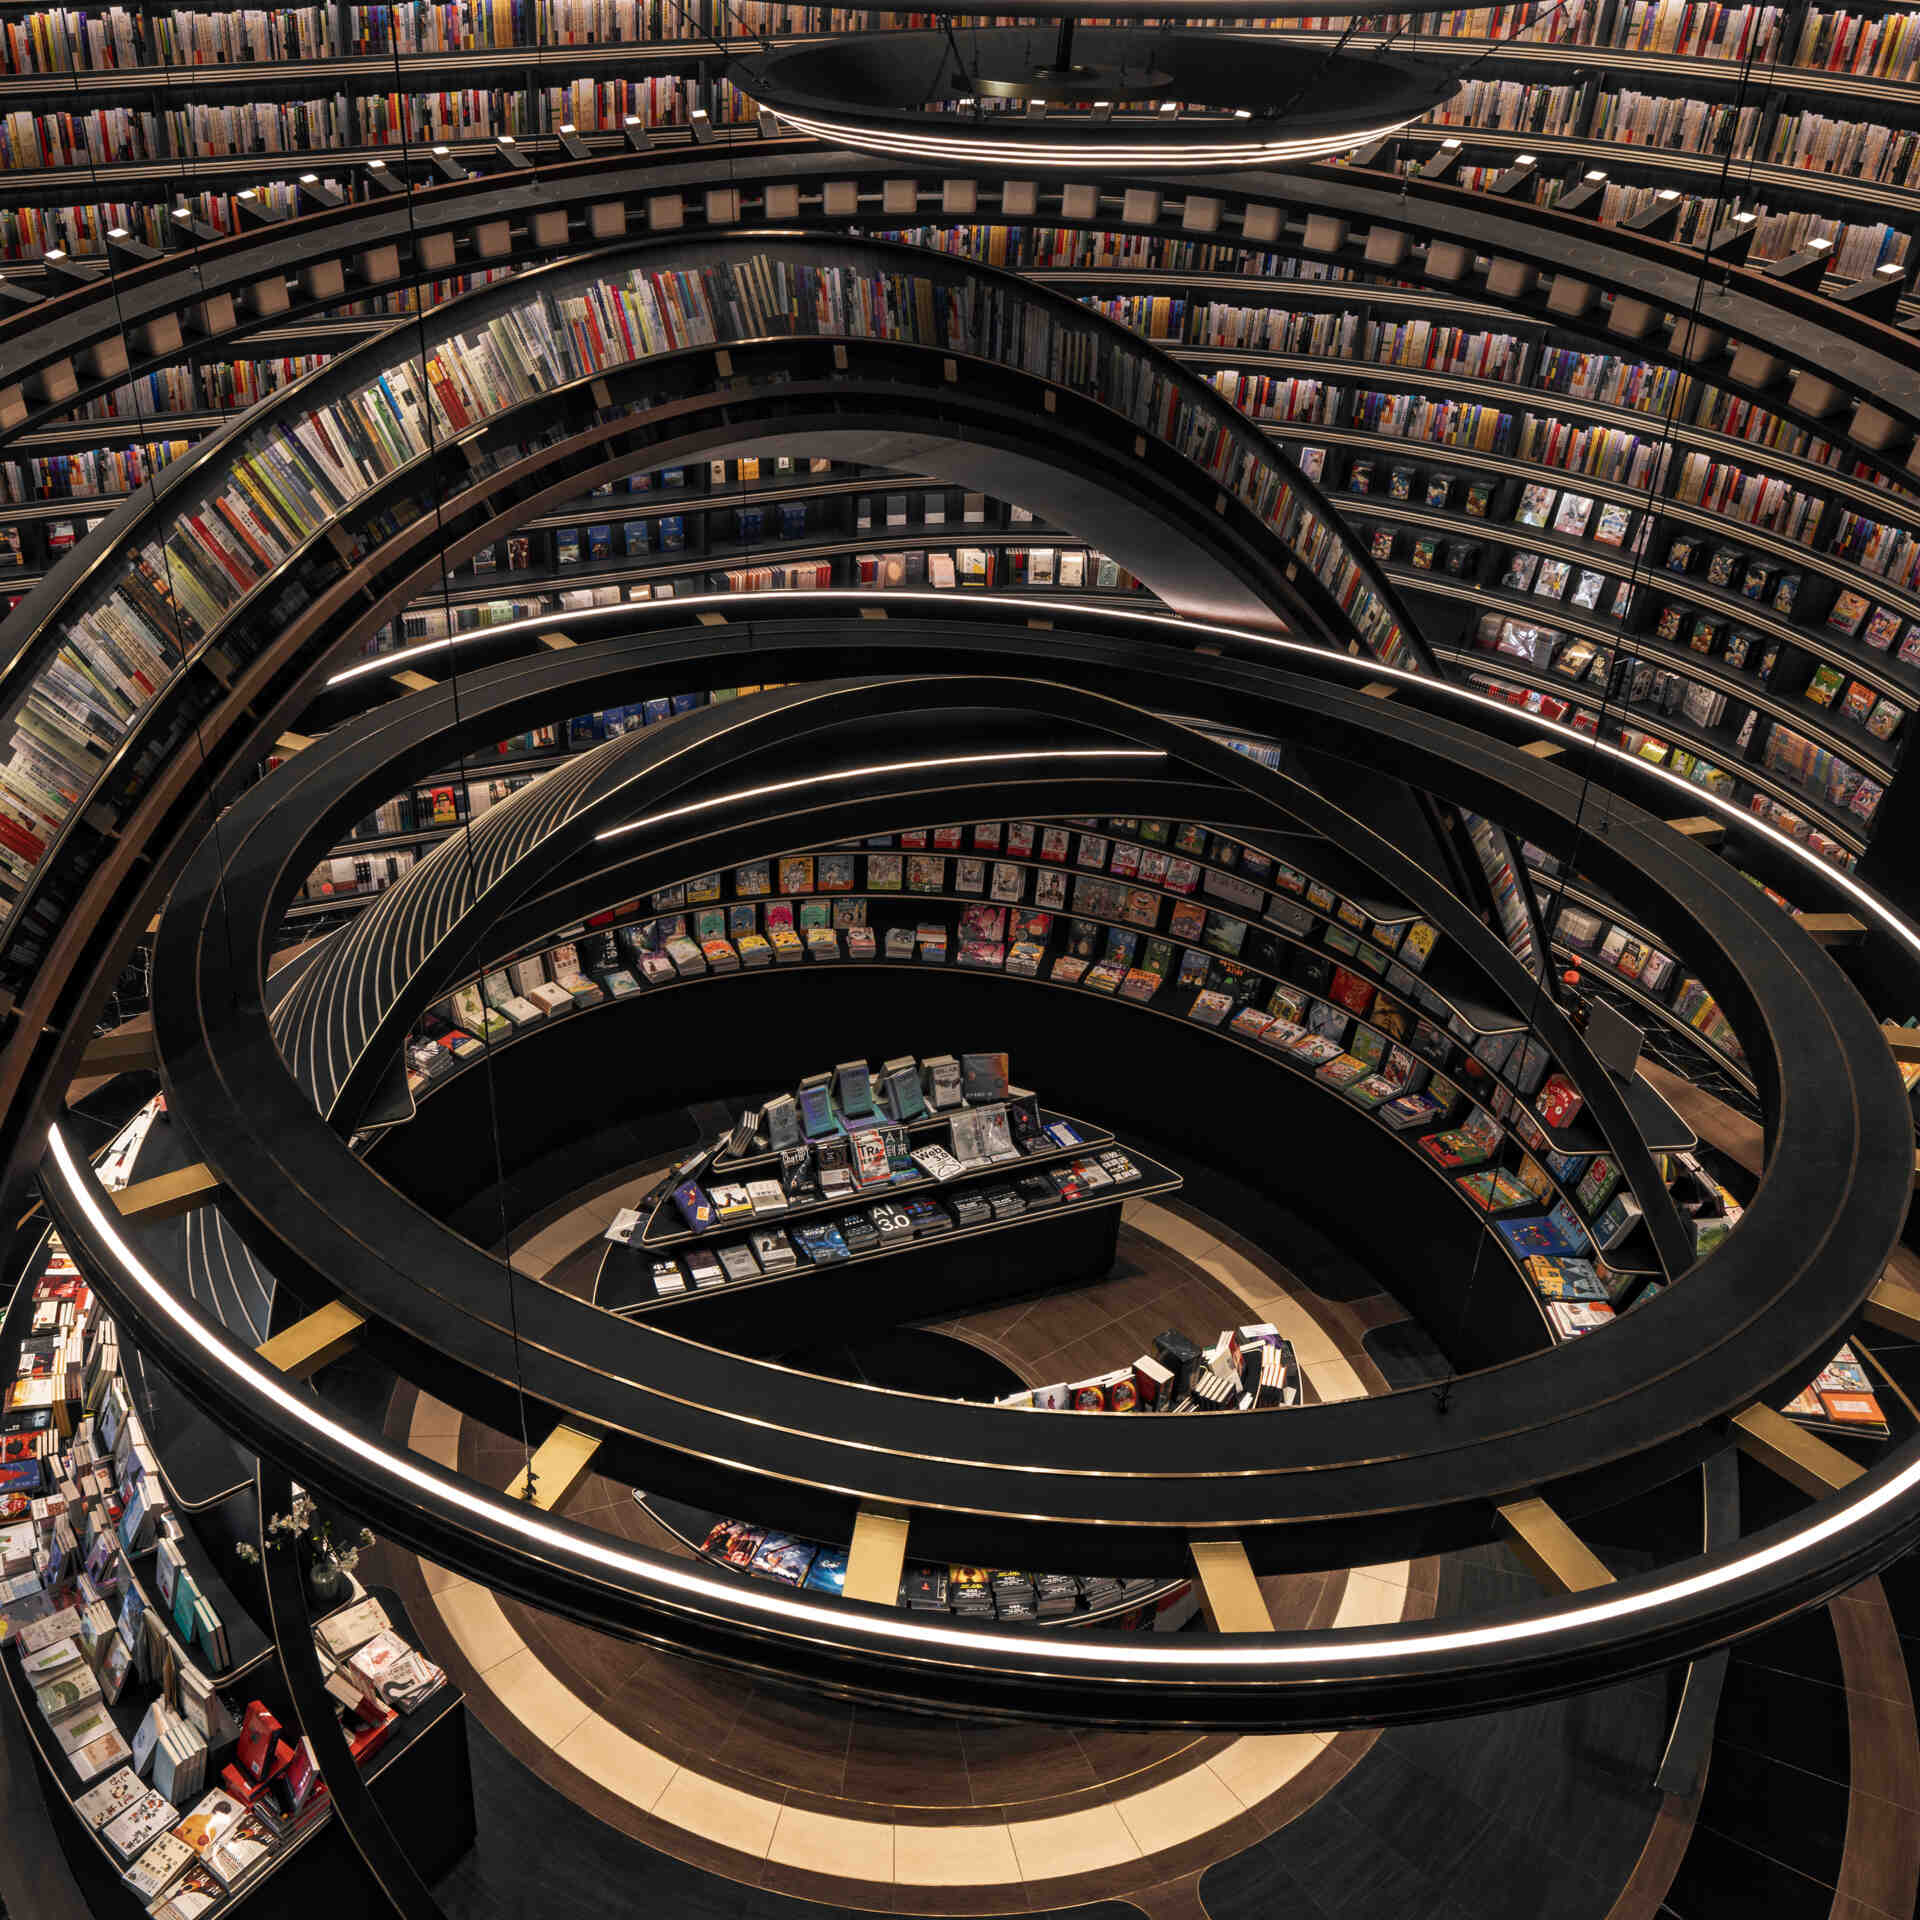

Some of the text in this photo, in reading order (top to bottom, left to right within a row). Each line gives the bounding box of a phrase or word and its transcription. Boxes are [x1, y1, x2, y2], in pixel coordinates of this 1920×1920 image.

[917, 1146, 942, 1162] Web
[873, 1203, 894, 1219] AI
[878, 1214, 911, 1231] 3.0
